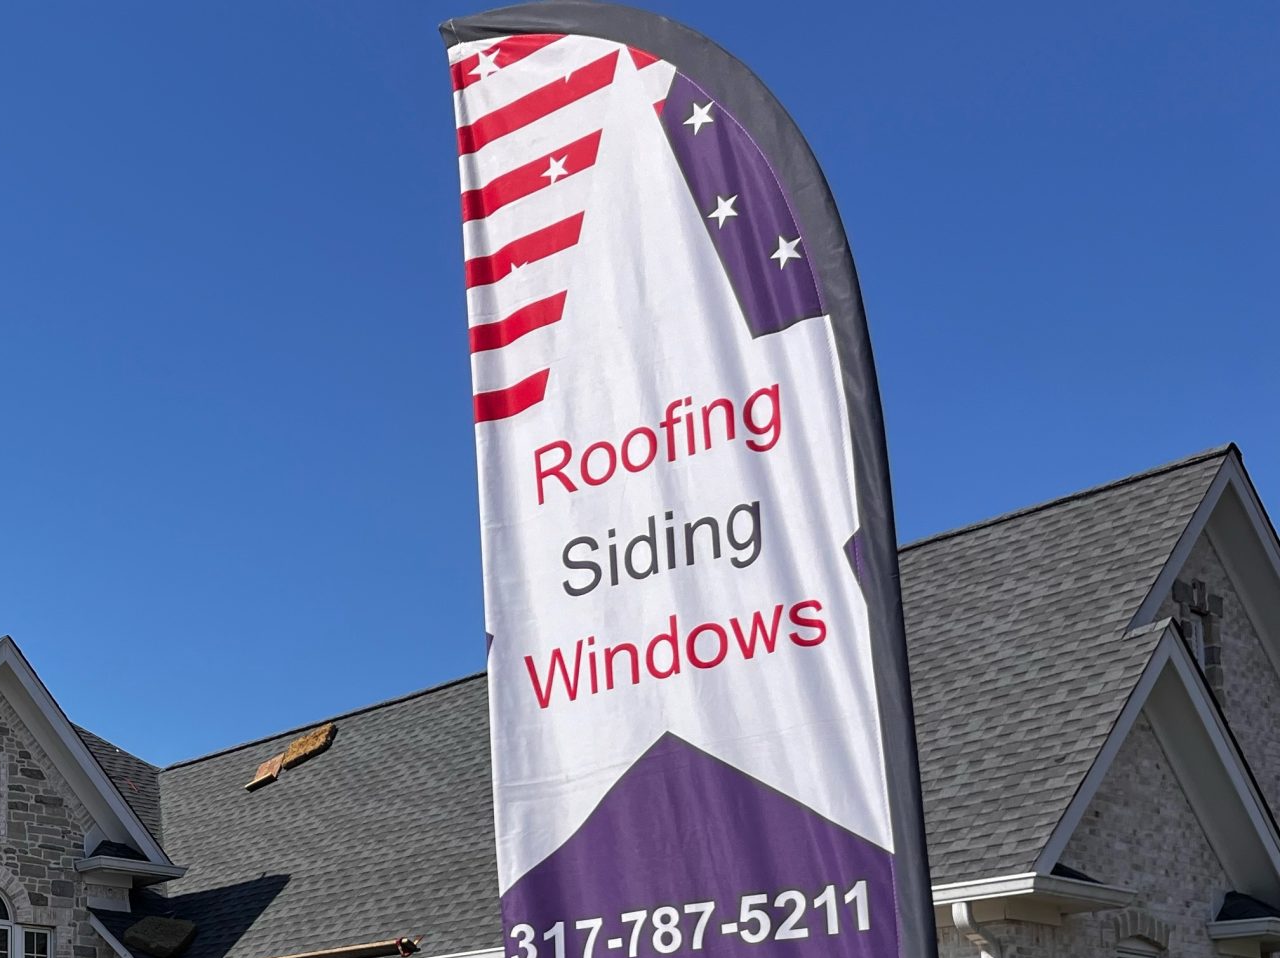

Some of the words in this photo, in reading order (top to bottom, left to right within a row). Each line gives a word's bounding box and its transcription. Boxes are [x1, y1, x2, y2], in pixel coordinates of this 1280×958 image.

[534, 384, 782, 505] Roofing
[562, 500, 762, 597] Siding
[524, 599, 827, 709] Windows
